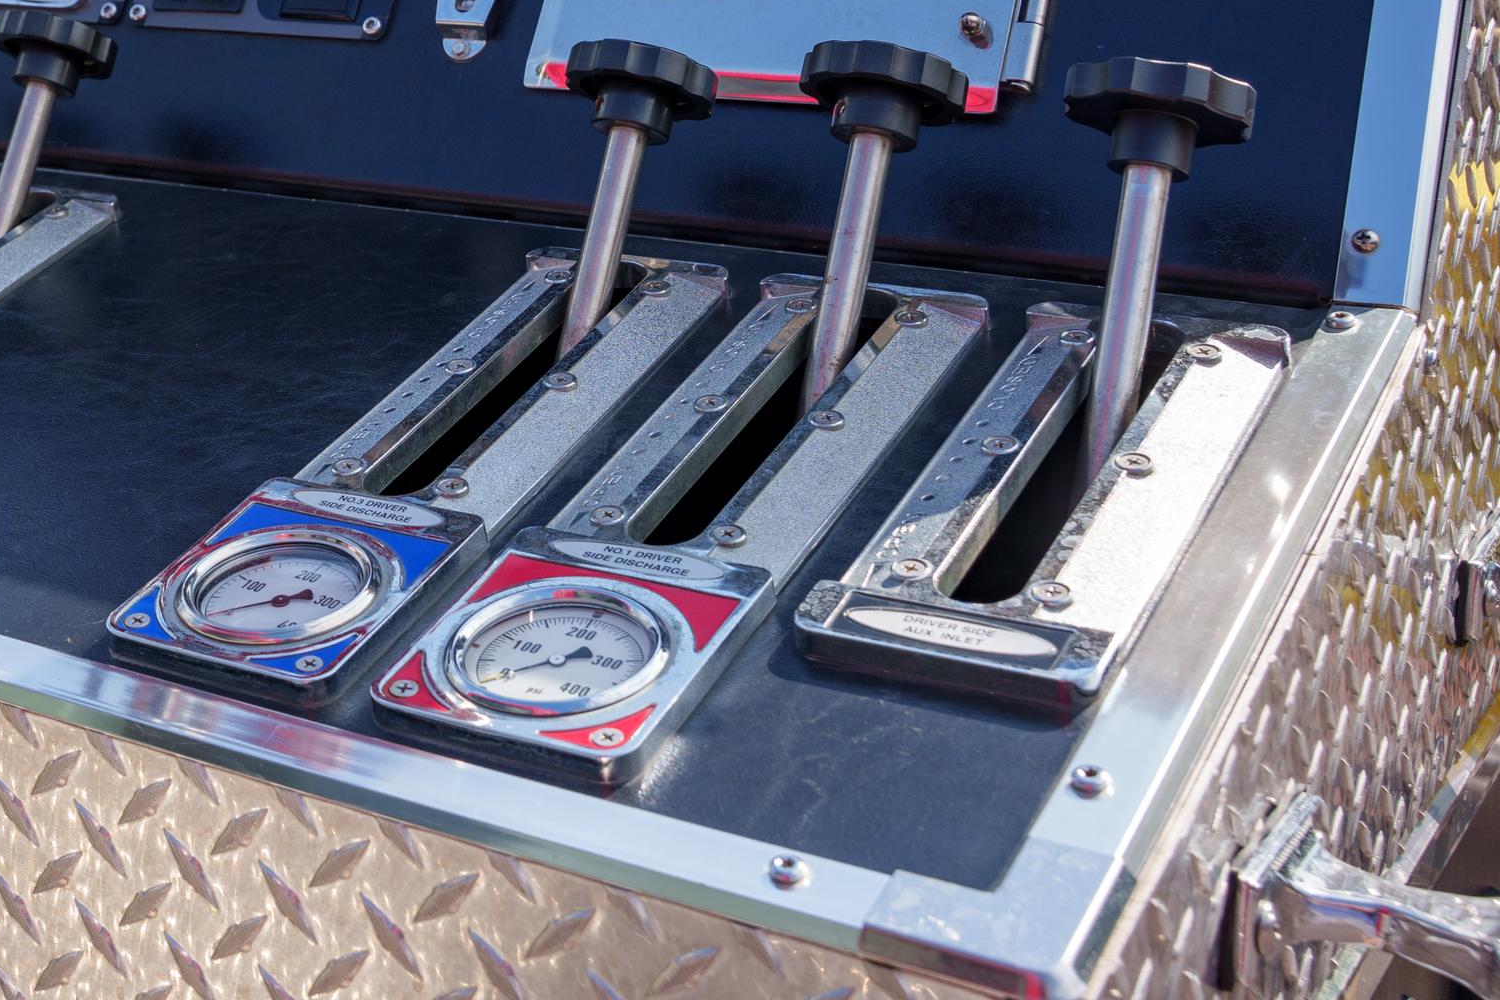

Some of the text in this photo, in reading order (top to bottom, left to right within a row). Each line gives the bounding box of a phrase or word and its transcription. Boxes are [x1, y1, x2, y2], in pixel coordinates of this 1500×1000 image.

[338, 494, 408, 513] NO.3 DRIVER
[319, 500, 413, 523] SIDE DISCHARGE
[603, 545, 682, 564] NO.1 DRIVER
[582, 551, 692, 577] SIDE DISCHARGE
[294, 569, 321, 583] 200
[240, 579, 266, 592] 100
[313, 595, 341, 610] 300
[903, 614, 997, 638] DRIVER SIDE
[565, 627, 597, 641] 200
[903, 625, 985, 646] AUX INLET
[512, 640, 542, 654] 100
[590, 654, 623, 670] 300
[525, 687, 545, 695] psi
[559, 682, 591, 697] 400
